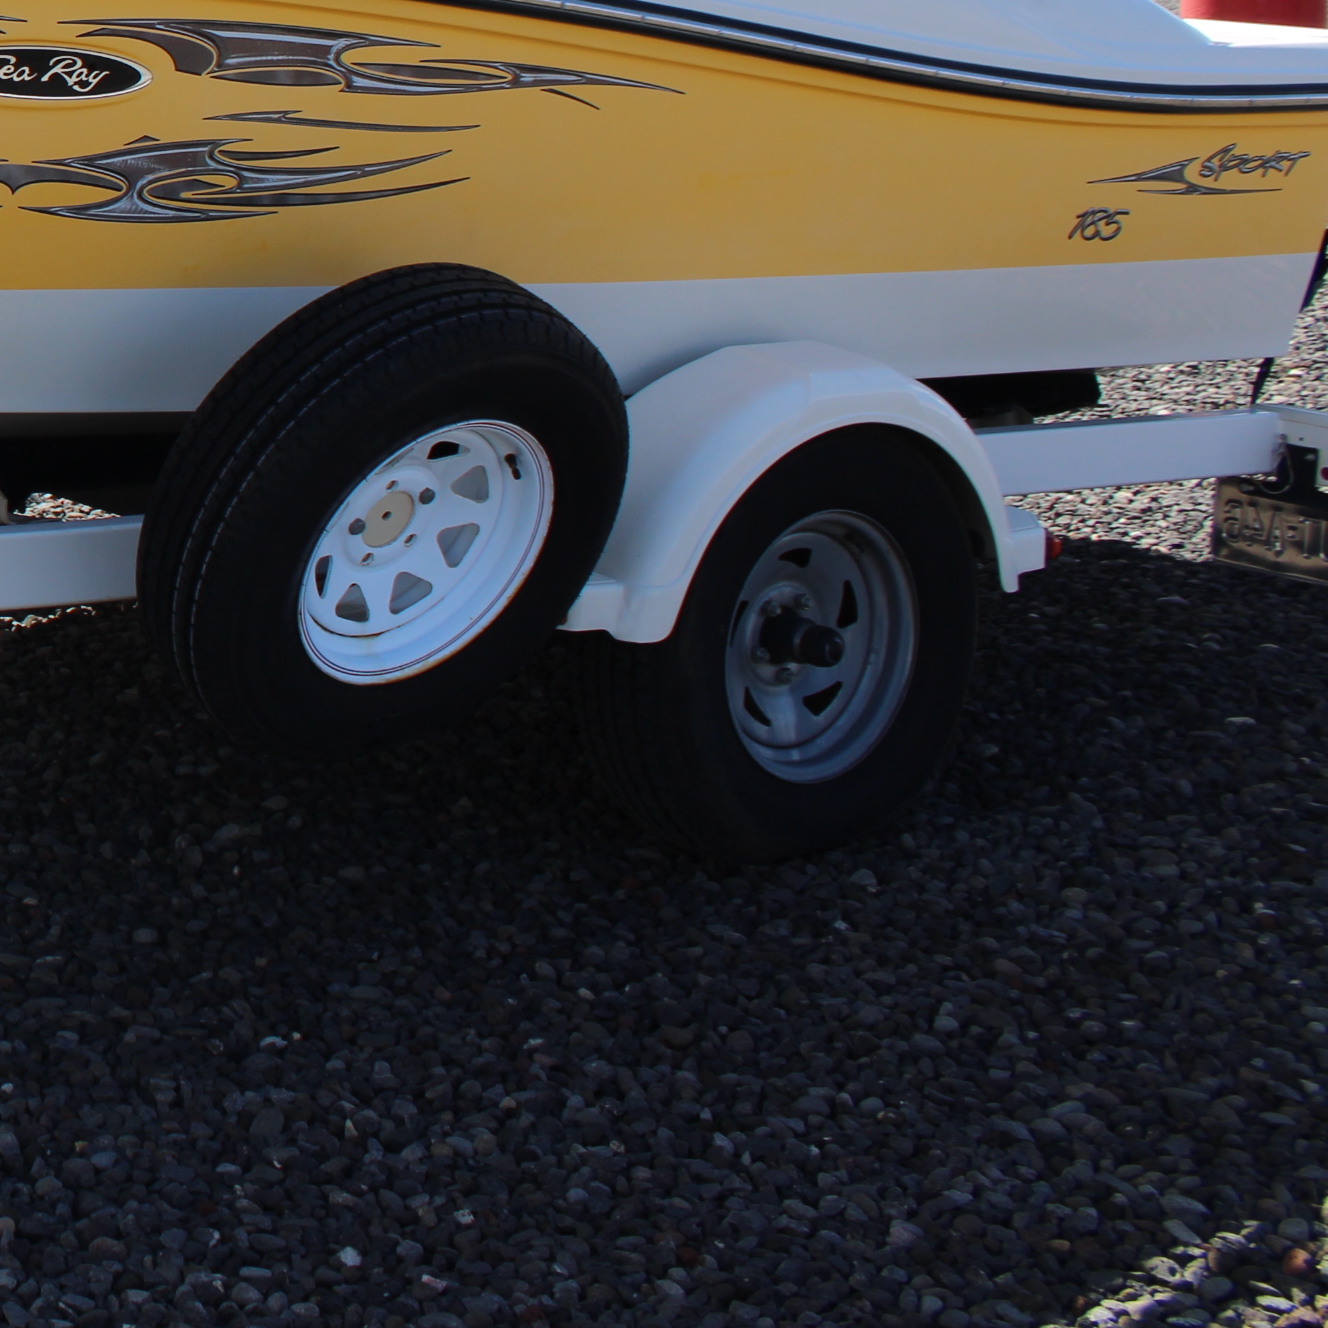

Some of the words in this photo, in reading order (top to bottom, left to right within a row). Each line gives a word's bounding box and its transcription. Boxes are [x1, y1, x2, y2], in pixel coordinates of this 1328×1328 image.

[41, 55, 110, 93] Ray
[1199, 142, 1312, 182] SPORT
[1068, 206, 1131, 242] 185
